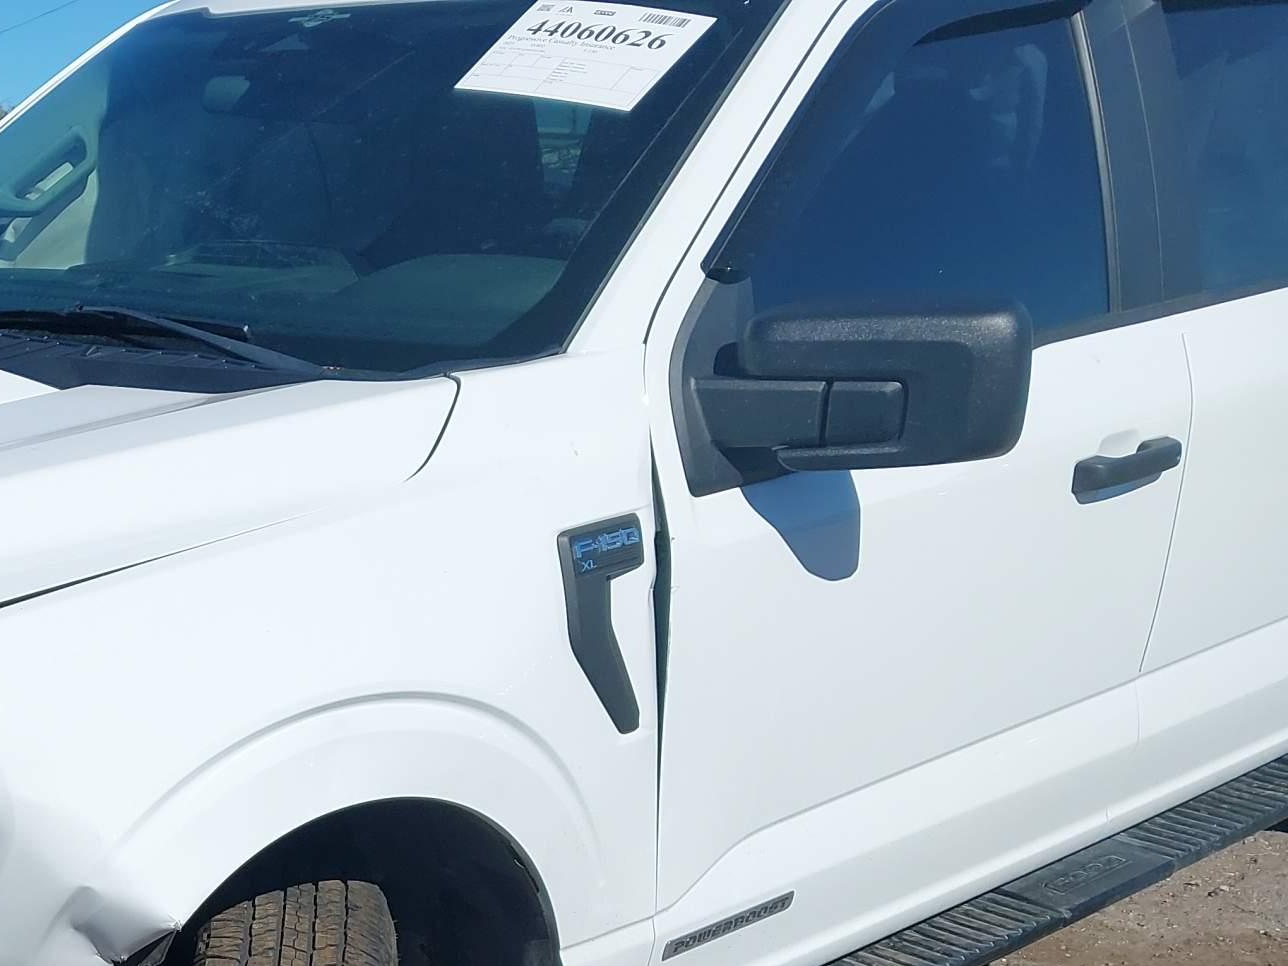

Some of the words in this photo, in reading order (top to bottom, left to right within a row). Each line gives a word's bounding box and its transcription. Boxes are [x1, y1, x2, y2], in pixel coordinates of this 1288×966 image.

[527, 19, 673, 50] 44060626
[574, 527, 640, 558] F-150
[581, 560, 598, 571] XL
[673, 899, 788, 953] POWERBOOST
